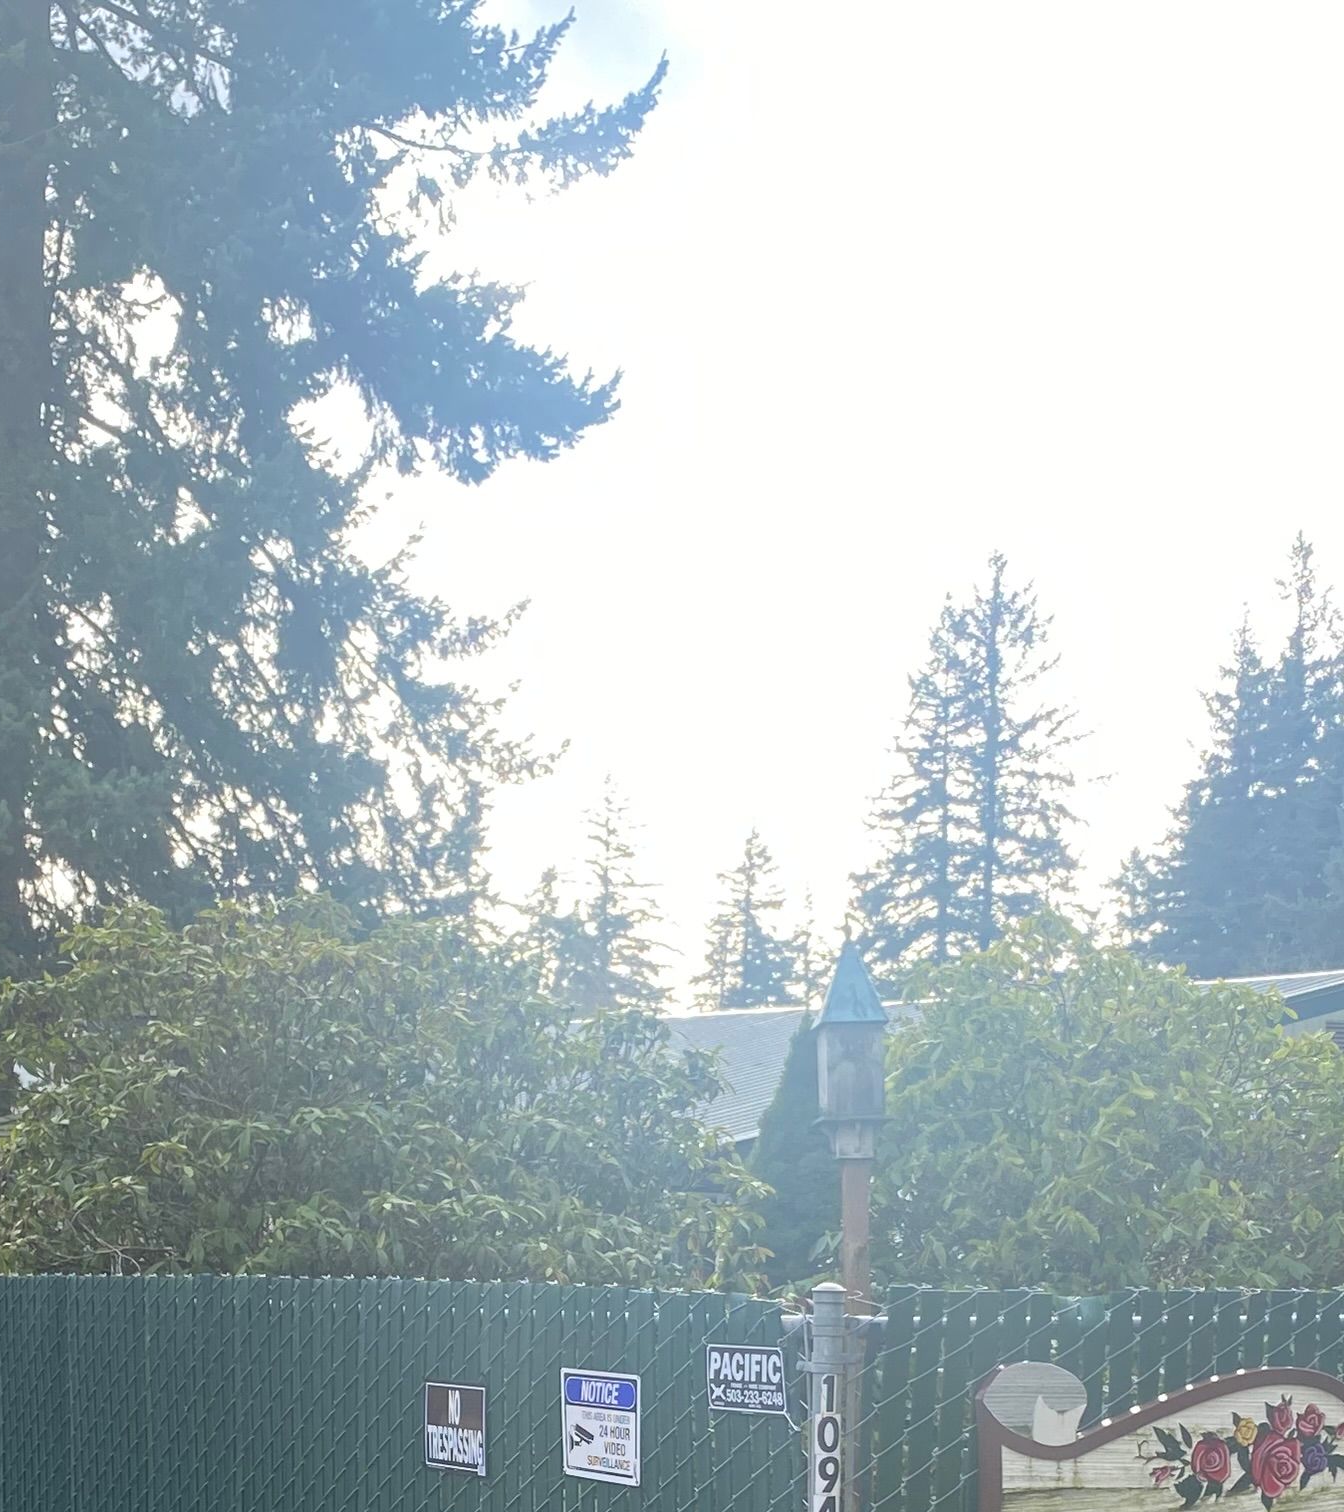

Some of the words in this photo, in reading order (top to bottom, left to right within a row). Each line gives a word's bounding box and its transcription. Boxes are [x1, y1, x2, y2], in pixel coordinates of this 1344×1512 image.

[709, 1351, 781, 1384] PACIFIC
[580, 1380, 619, 1404] NOTICE
[448, 1390, 460, 1425] NO
[599, 1425, 608, 1438] 24
[610, 1426, 631, 1441] HOUR
[427, 1425, 484, 1466] TRESPASSING
[604, 1441, 626, 1457] VIDEO
[587, 1455, 631, 1472] SURVEILLANCE
